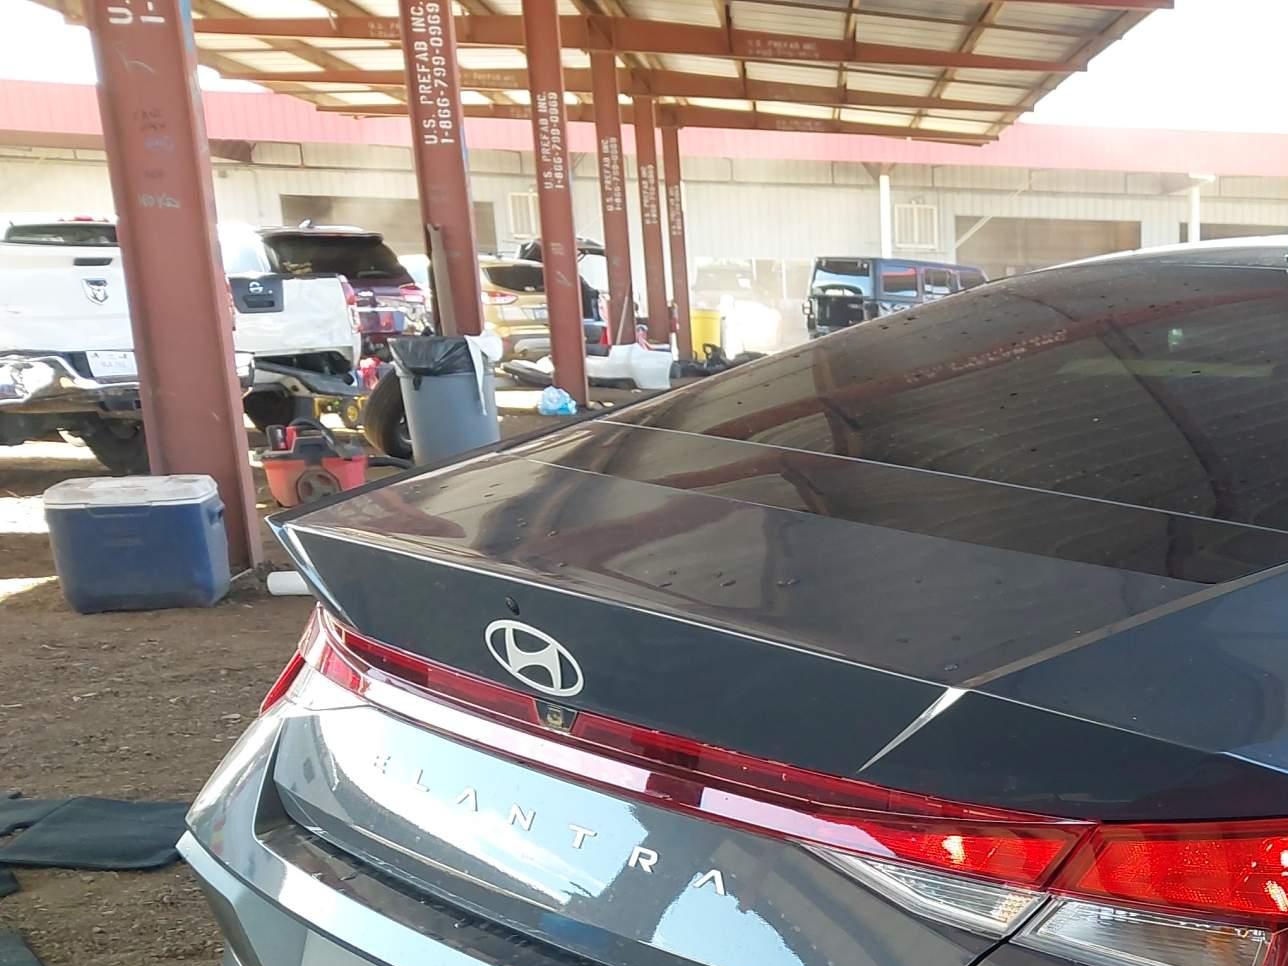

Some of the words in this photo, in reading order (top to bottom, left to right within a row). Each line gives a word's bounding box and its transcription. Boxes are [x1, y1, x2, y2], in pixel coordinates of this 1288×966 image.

[410, 1, 427, 32] INC.
[414, 41, 435, 105] PREFAB
[426, 2, 455, 144] 1-866-799-0969
[423, 114, 438, 145] U.S.
[373, 752, 727, 896] ELANTRA
